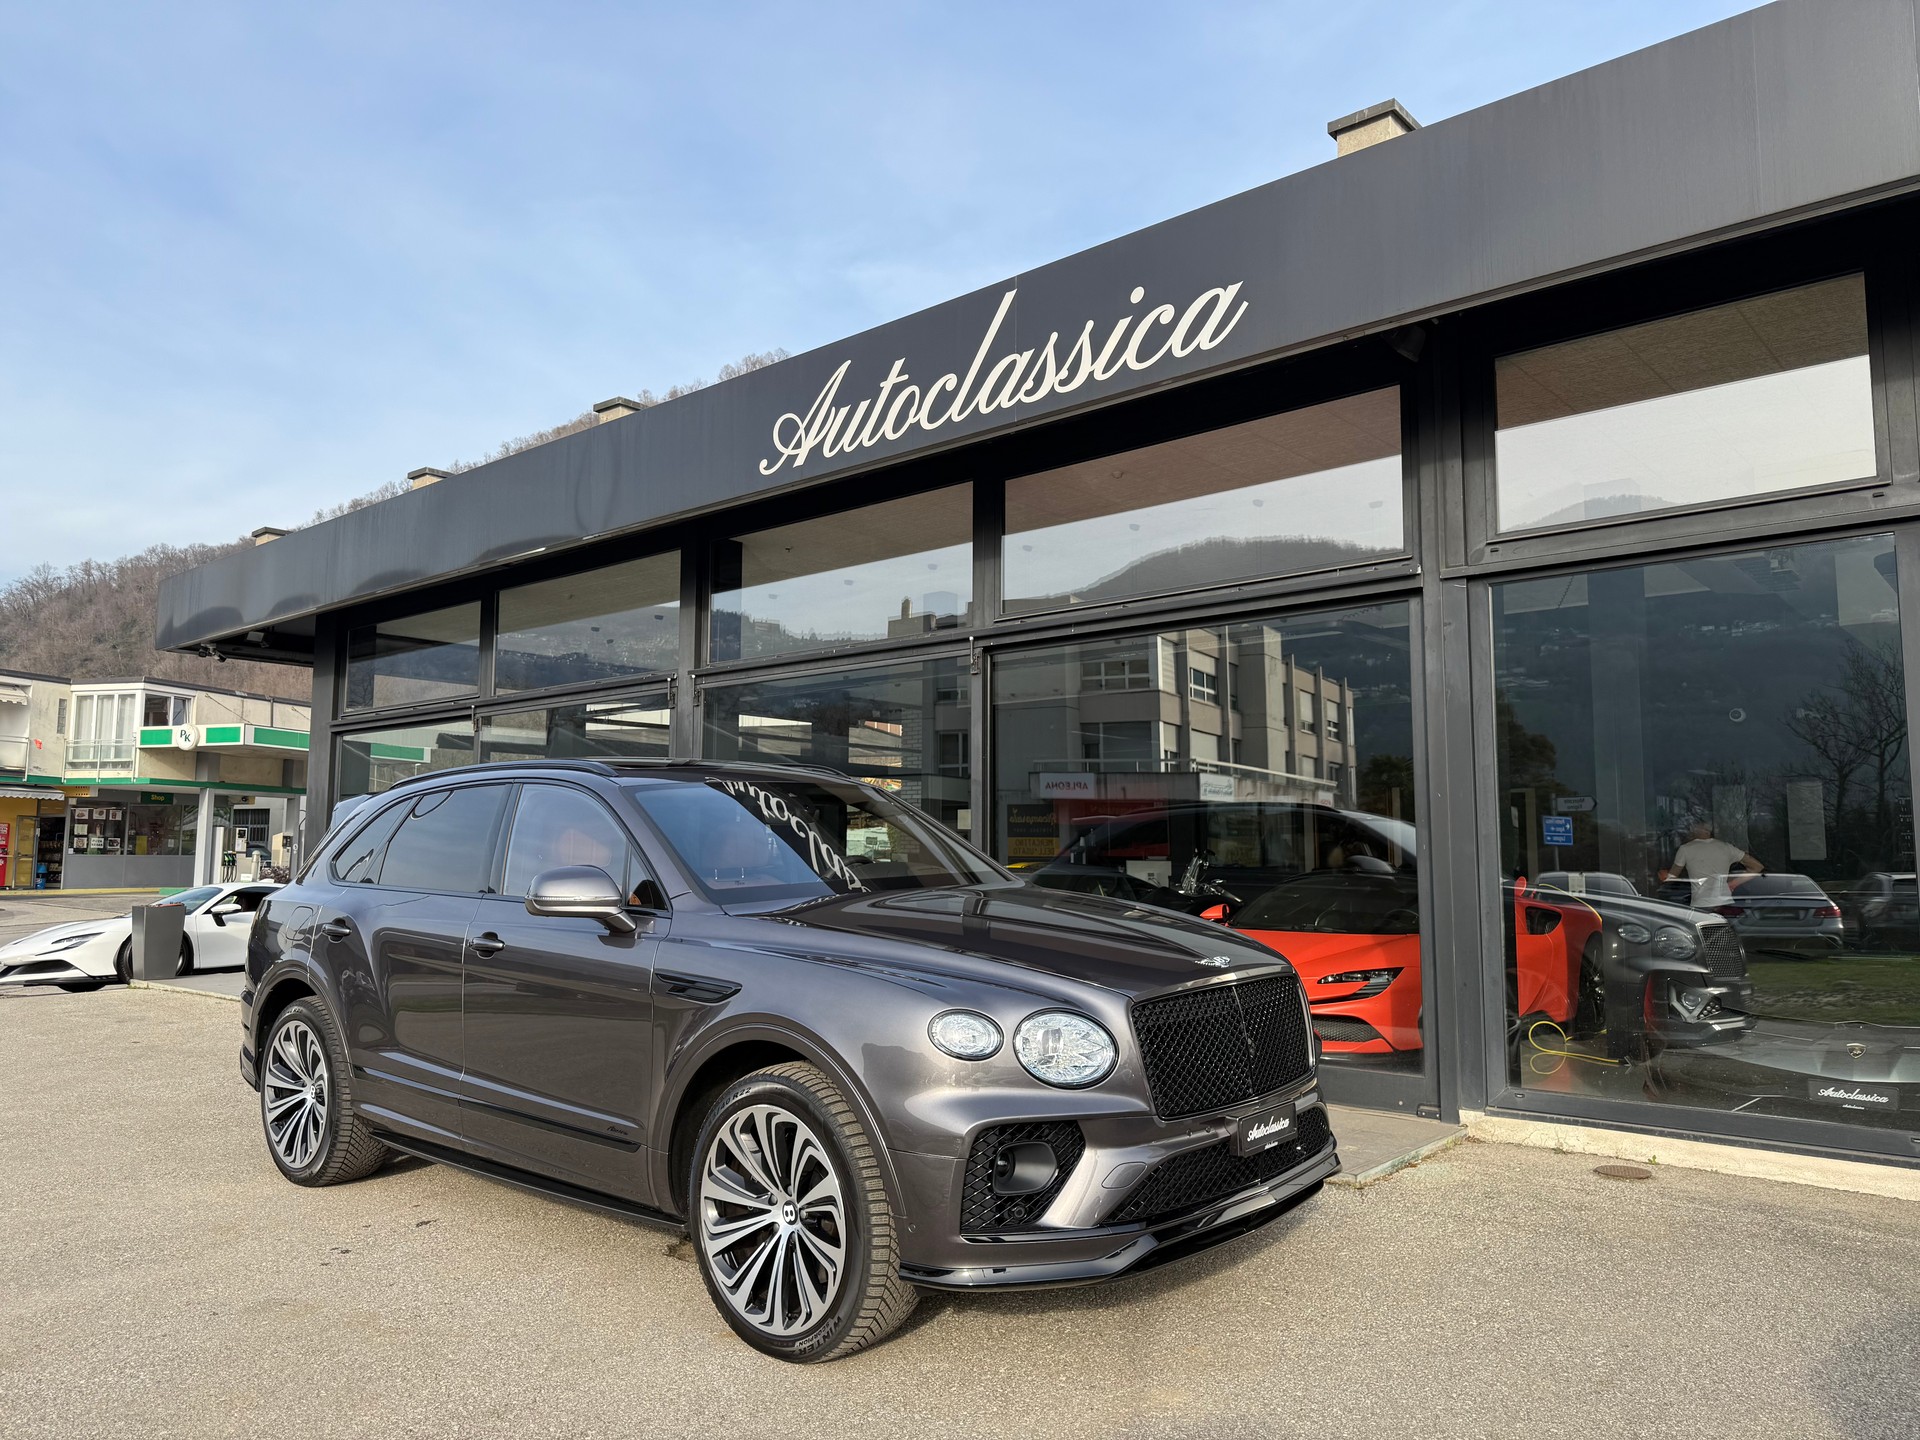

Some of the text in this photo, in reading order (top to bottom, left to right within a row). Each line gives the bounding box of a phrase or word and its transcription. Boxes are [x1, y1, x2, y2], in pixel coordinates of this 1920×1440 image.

[759, 280, 1249, 475] Autoclassica
[150, 794, 165, 802] Shop
[1817, 1087, 1889, 1103] Autoclassica
[1247, 1116, 1290, 1142] Autoclassica
[797, 1321, 831, 1347] SCORPION
[799, 1315, 843, 1356] WINTER
